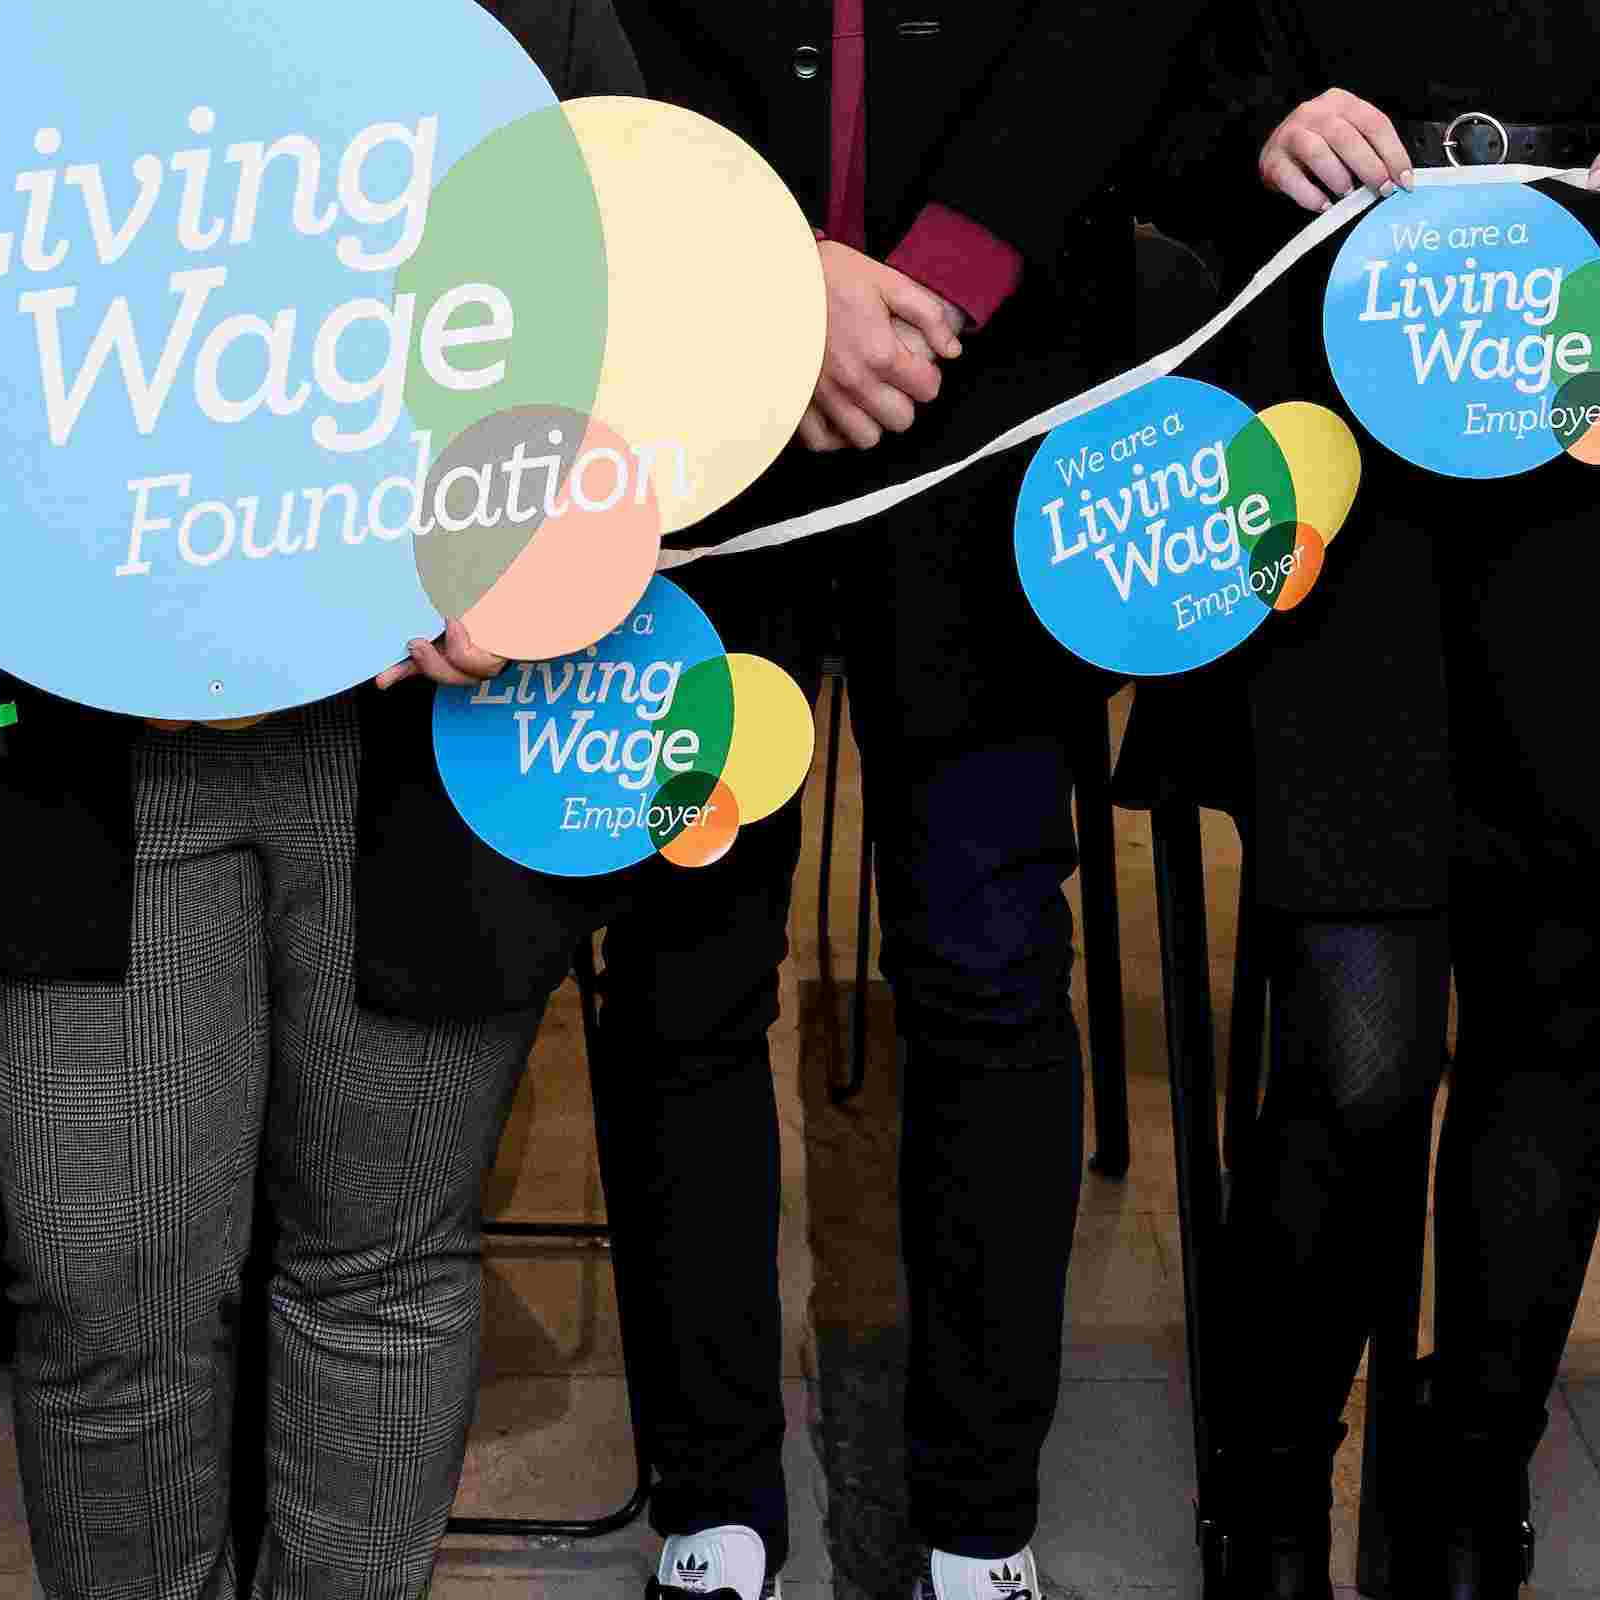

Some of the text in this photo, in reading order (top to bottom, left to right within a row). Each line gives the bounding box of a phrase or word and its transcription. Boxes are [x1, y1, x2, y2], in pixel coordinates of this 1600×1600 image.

[1388, 220, 1529, 254] We are a
[1358, 256, 1563, 325] Living
[18, 267, 514, 454] Wage
[1403, 320, 1593, 394] Wage
[1055, 412, 1184, 488] We are a
[114, 431, 694, 577] Foundation
[1041, 439, 1230, 566] Living
[1095, 492, 1272, 602] Wage
[632, 612, 654, 634] a
[1171, 544, 1305, 631] Employer
[513, 710, 700, 790] Wage
[559, 793, 718, 837] Employer
